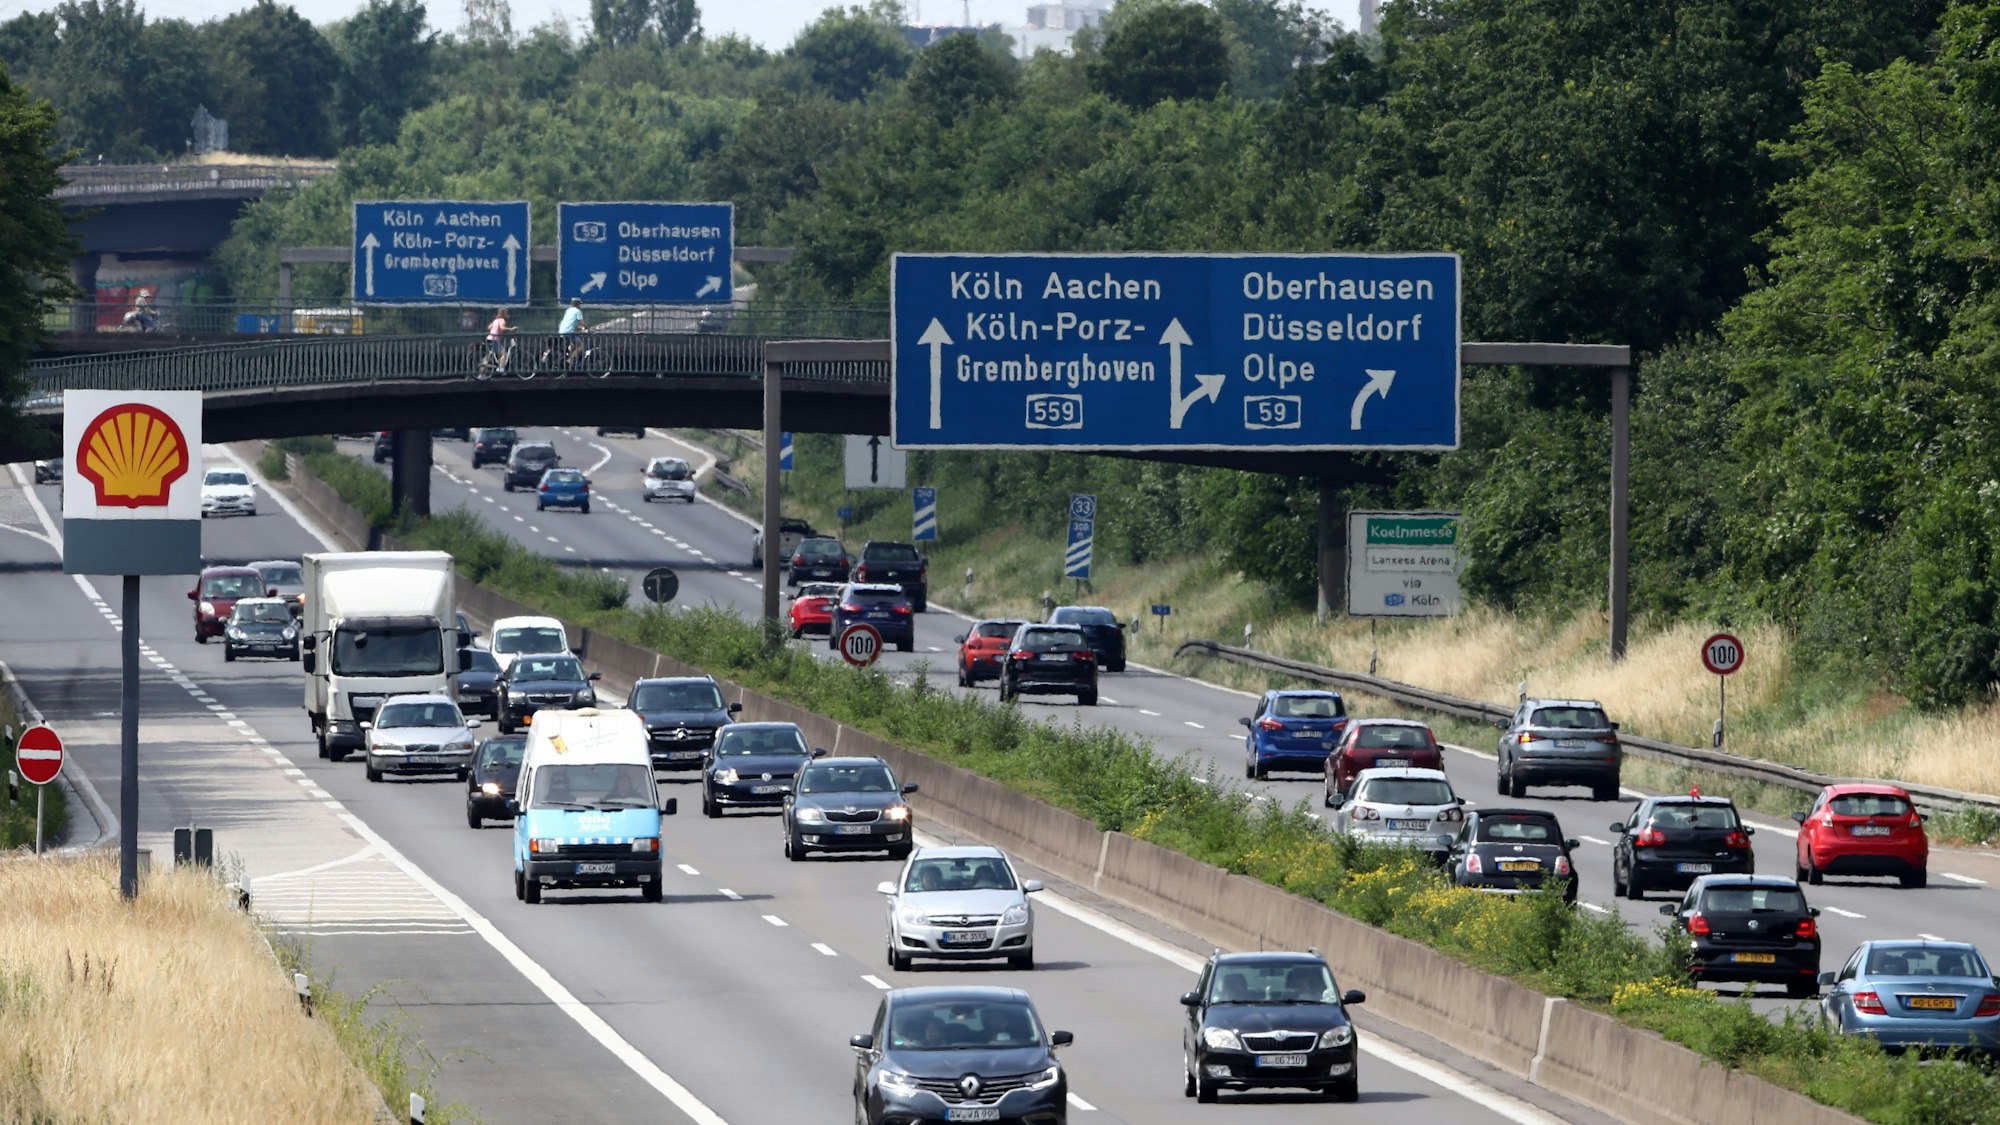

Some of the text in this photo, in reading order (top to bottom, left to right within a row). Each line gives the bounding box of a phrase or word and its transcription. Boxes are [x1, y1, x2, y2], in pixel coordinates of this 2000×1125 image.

[383, 210, 501, 227] Köln Aachen
[582, 221, 721, 239] 59 Oberhausen
[385, 253, 499, 273] Gremberghoven
[618, 245, 715, 262] Düsseldorf
[618, 270, 658, 291] Olpe
[951, 271, 1161, 300] Köln Aachen
[1243, 271, 1434, 300] Oberhausen
[966, 312, 1145, 341] Köln-Porz-
[1243, 313, 1422, 341] Düsseldorf
[957, 353, 1155, 389] Gremberghoven
[1243, 353, 1315, 389] Olpe
[1033, 401, 1075, 422] 559
[1258, 402, 1287, 422] 59
[1075, 500, 1091, 514] 33
[1073, 522, 1089, 531] 300
[1371, 525, 1452, 538] Koelnmesse
[1372, 555, 1450, 566] Lanxess Arena
[1402, 579, 1422, 588] via
[1412, 594, 1440, 606] Köln
[849, 636, 874, 654] 100
[1710, 645, 1735, 664] 100
